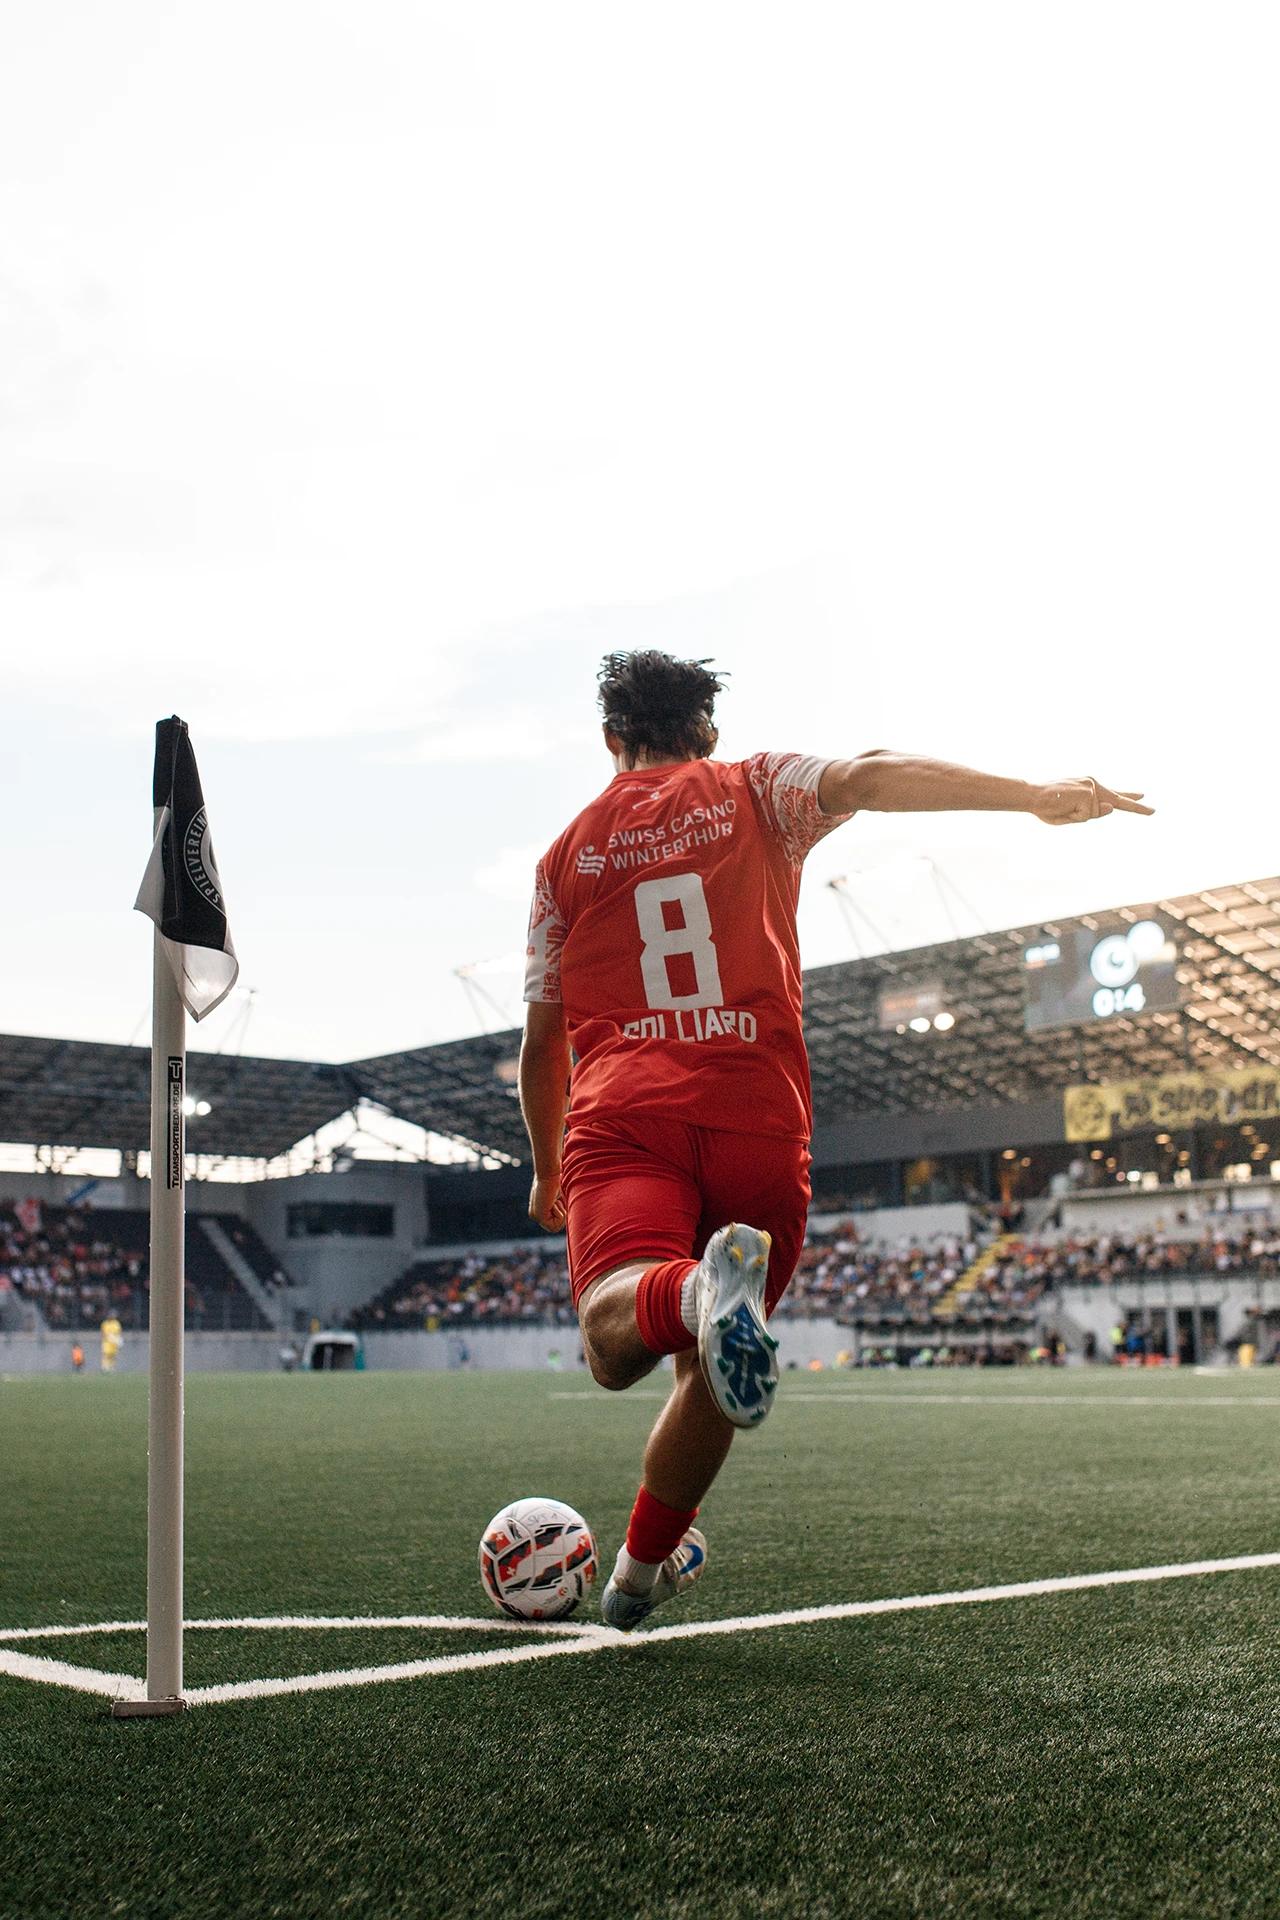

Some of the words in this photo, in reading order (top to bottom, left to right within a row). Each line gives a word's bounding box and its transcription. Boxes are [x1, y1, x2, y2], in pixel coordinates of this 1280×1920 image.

[608, 826, 666, 849] SWISS
[670, 799, 737, 834] CASINO
[610, 822, 733, 870] WINTERTHUR
[634, 872, 724, 1011] 8
